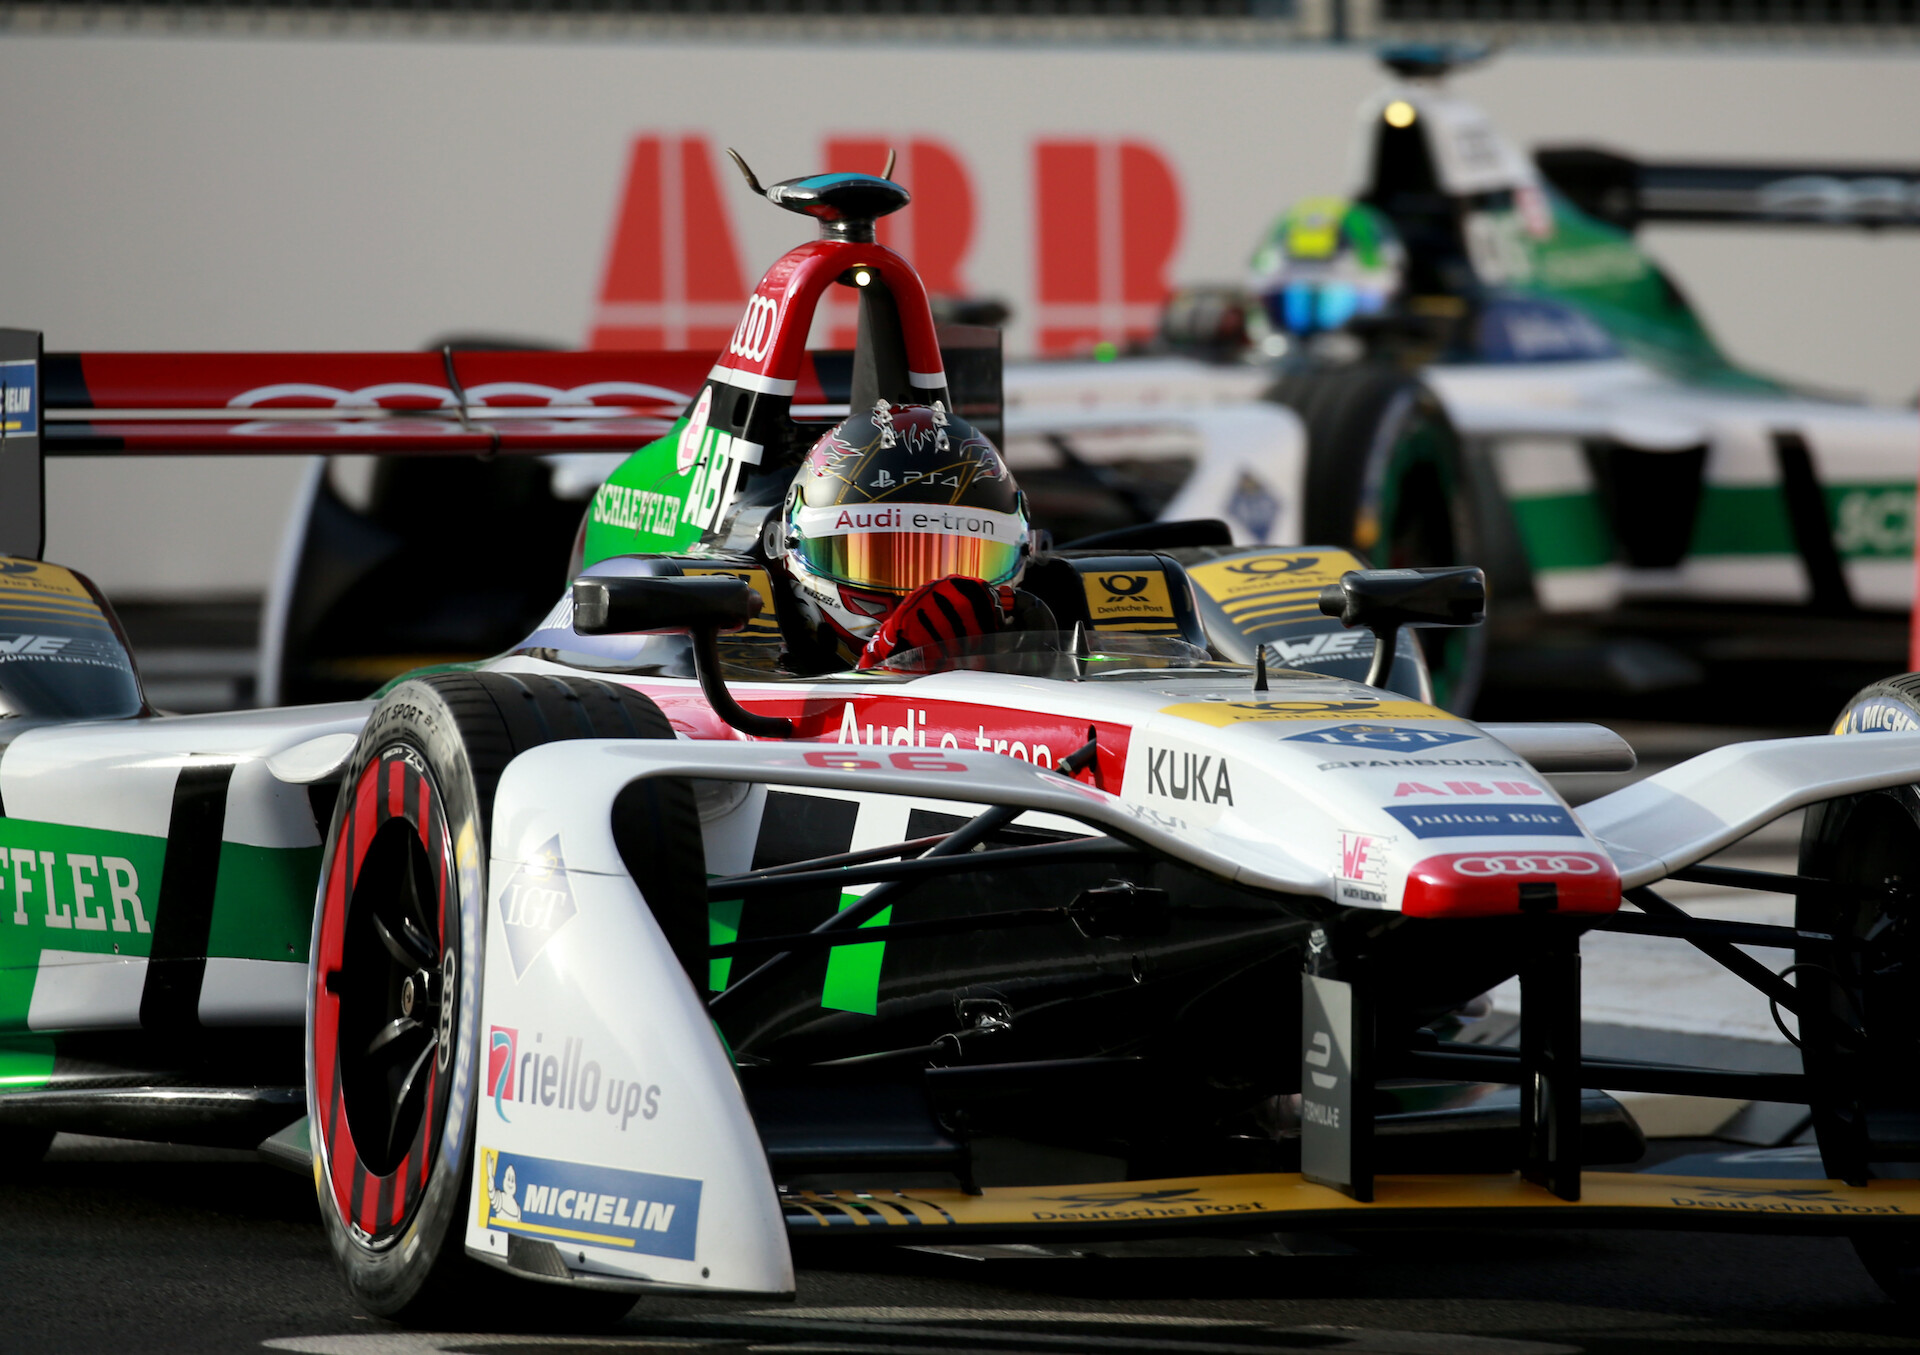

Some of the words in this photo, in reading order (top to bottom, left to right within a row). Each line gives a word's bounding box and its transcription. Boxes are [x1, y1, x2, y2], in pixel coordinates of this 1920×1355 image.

[681, 428, 764, 534] ABT
[903, 471, 960, 488] PS4
[594, 482, 681, 537] SCHAEFFLER
[834, 508, 901, 530] Audi
[912, 511, 995, 536] e-tron
[1097, 605, 1142, 614] Deutsche
[1143, 604, 1164, 613] Post
[1271, 631, 1365, 661] WE
[391, 703, 423, 725] SPORT
[803, 751, 968, 773] 66
[1349, 759, 1524, 769] FANBOOST
[1147, 746, 1234, 807] KUKA
[1394, 781, 1543, 797] ABB
[1410, 813, 1499, 827] Julius
[1507, 812, 1564, 824] Bär
[1343, 833, 1375, 880] WE
[505, 884, 567, 931] LGT
[447, 912, 476, 1150] MICHELIN
[518, 1033, 602, 1112] riello
[606, 1077, 662, 1131] ups
[523, 1184, 675, 1232] MICHELIN
[1032, 1206, 1188, 1222] Deutsche
[1194, 1200, 1268, 1214] Post
[1671, 1197, 1824, 1214] Deutsche
[1832, 1203, 1904, 1215] Post
